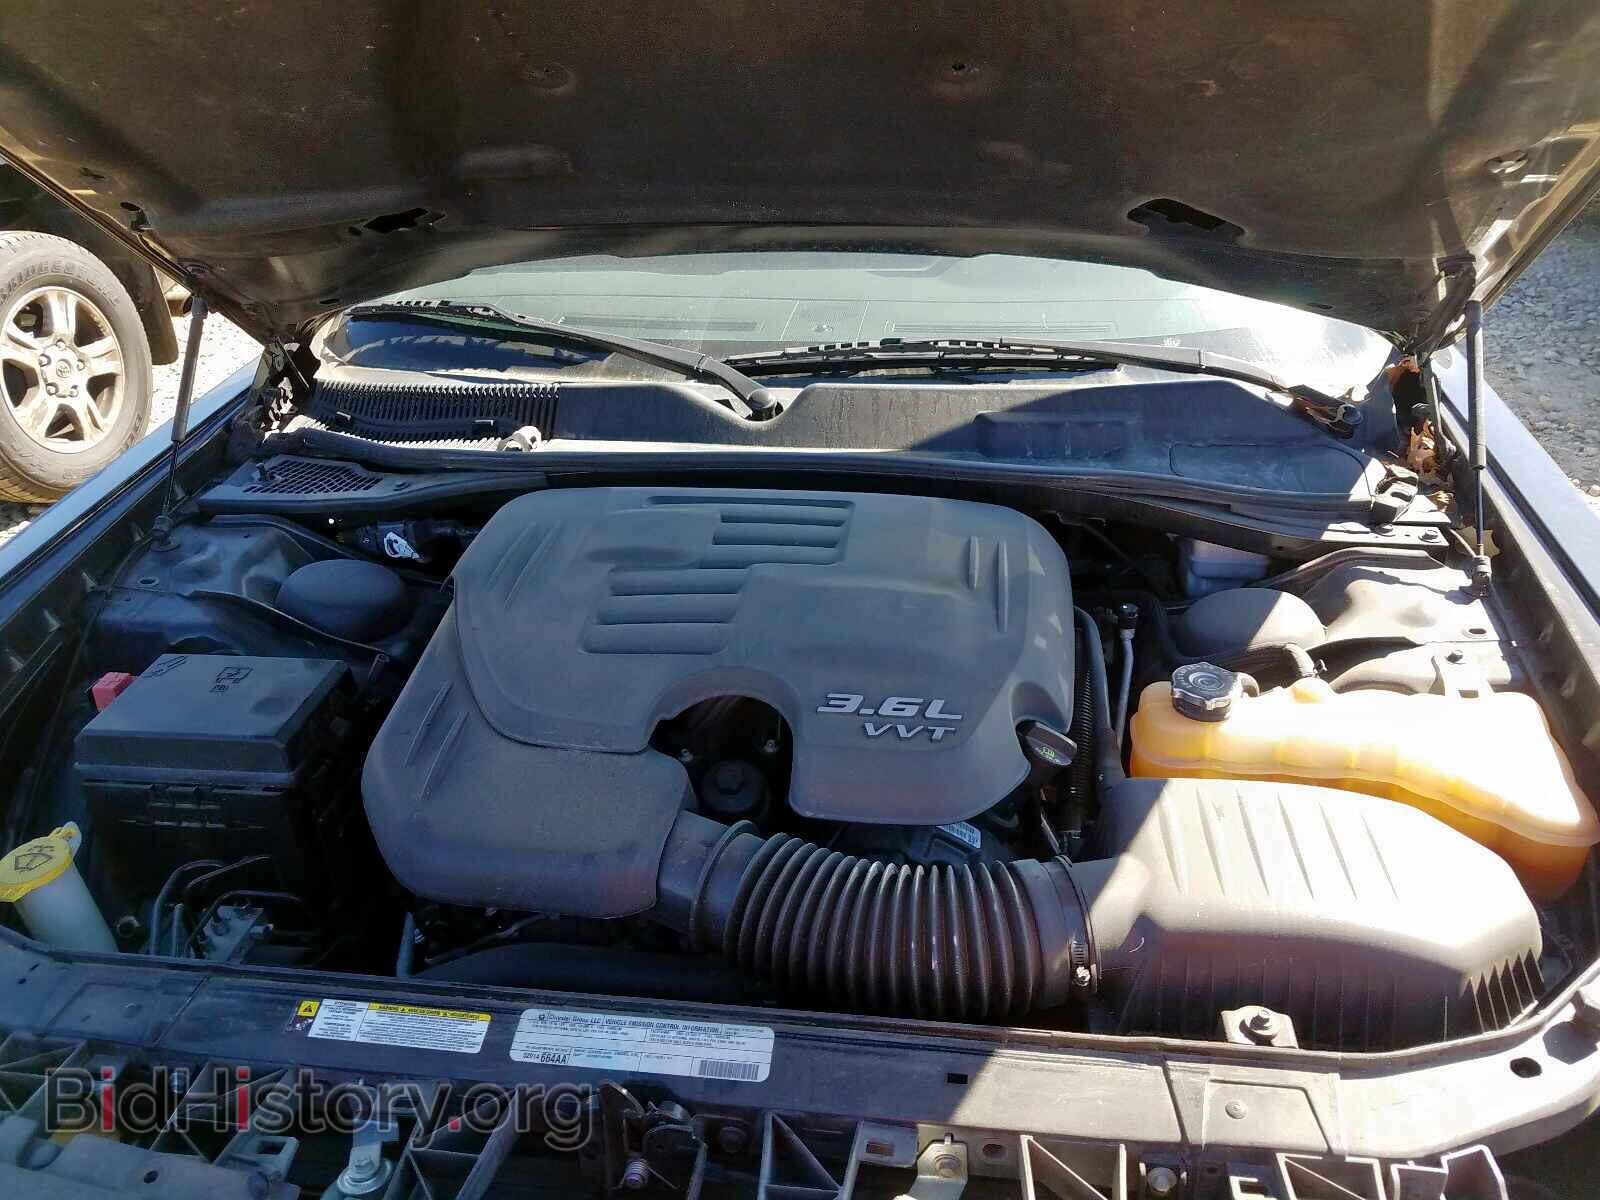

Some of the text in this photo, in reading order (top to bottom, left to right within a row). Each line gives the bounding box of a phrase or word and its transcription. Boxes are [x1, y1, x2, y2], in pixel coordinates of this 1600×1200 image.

[818, 693, 963, 720] 3.6L
[865, 722, 957, 742] VVT
[655, 1022, 680, 1031] CONTROL
[682, 1024, 720, 1033] INFORMATION
